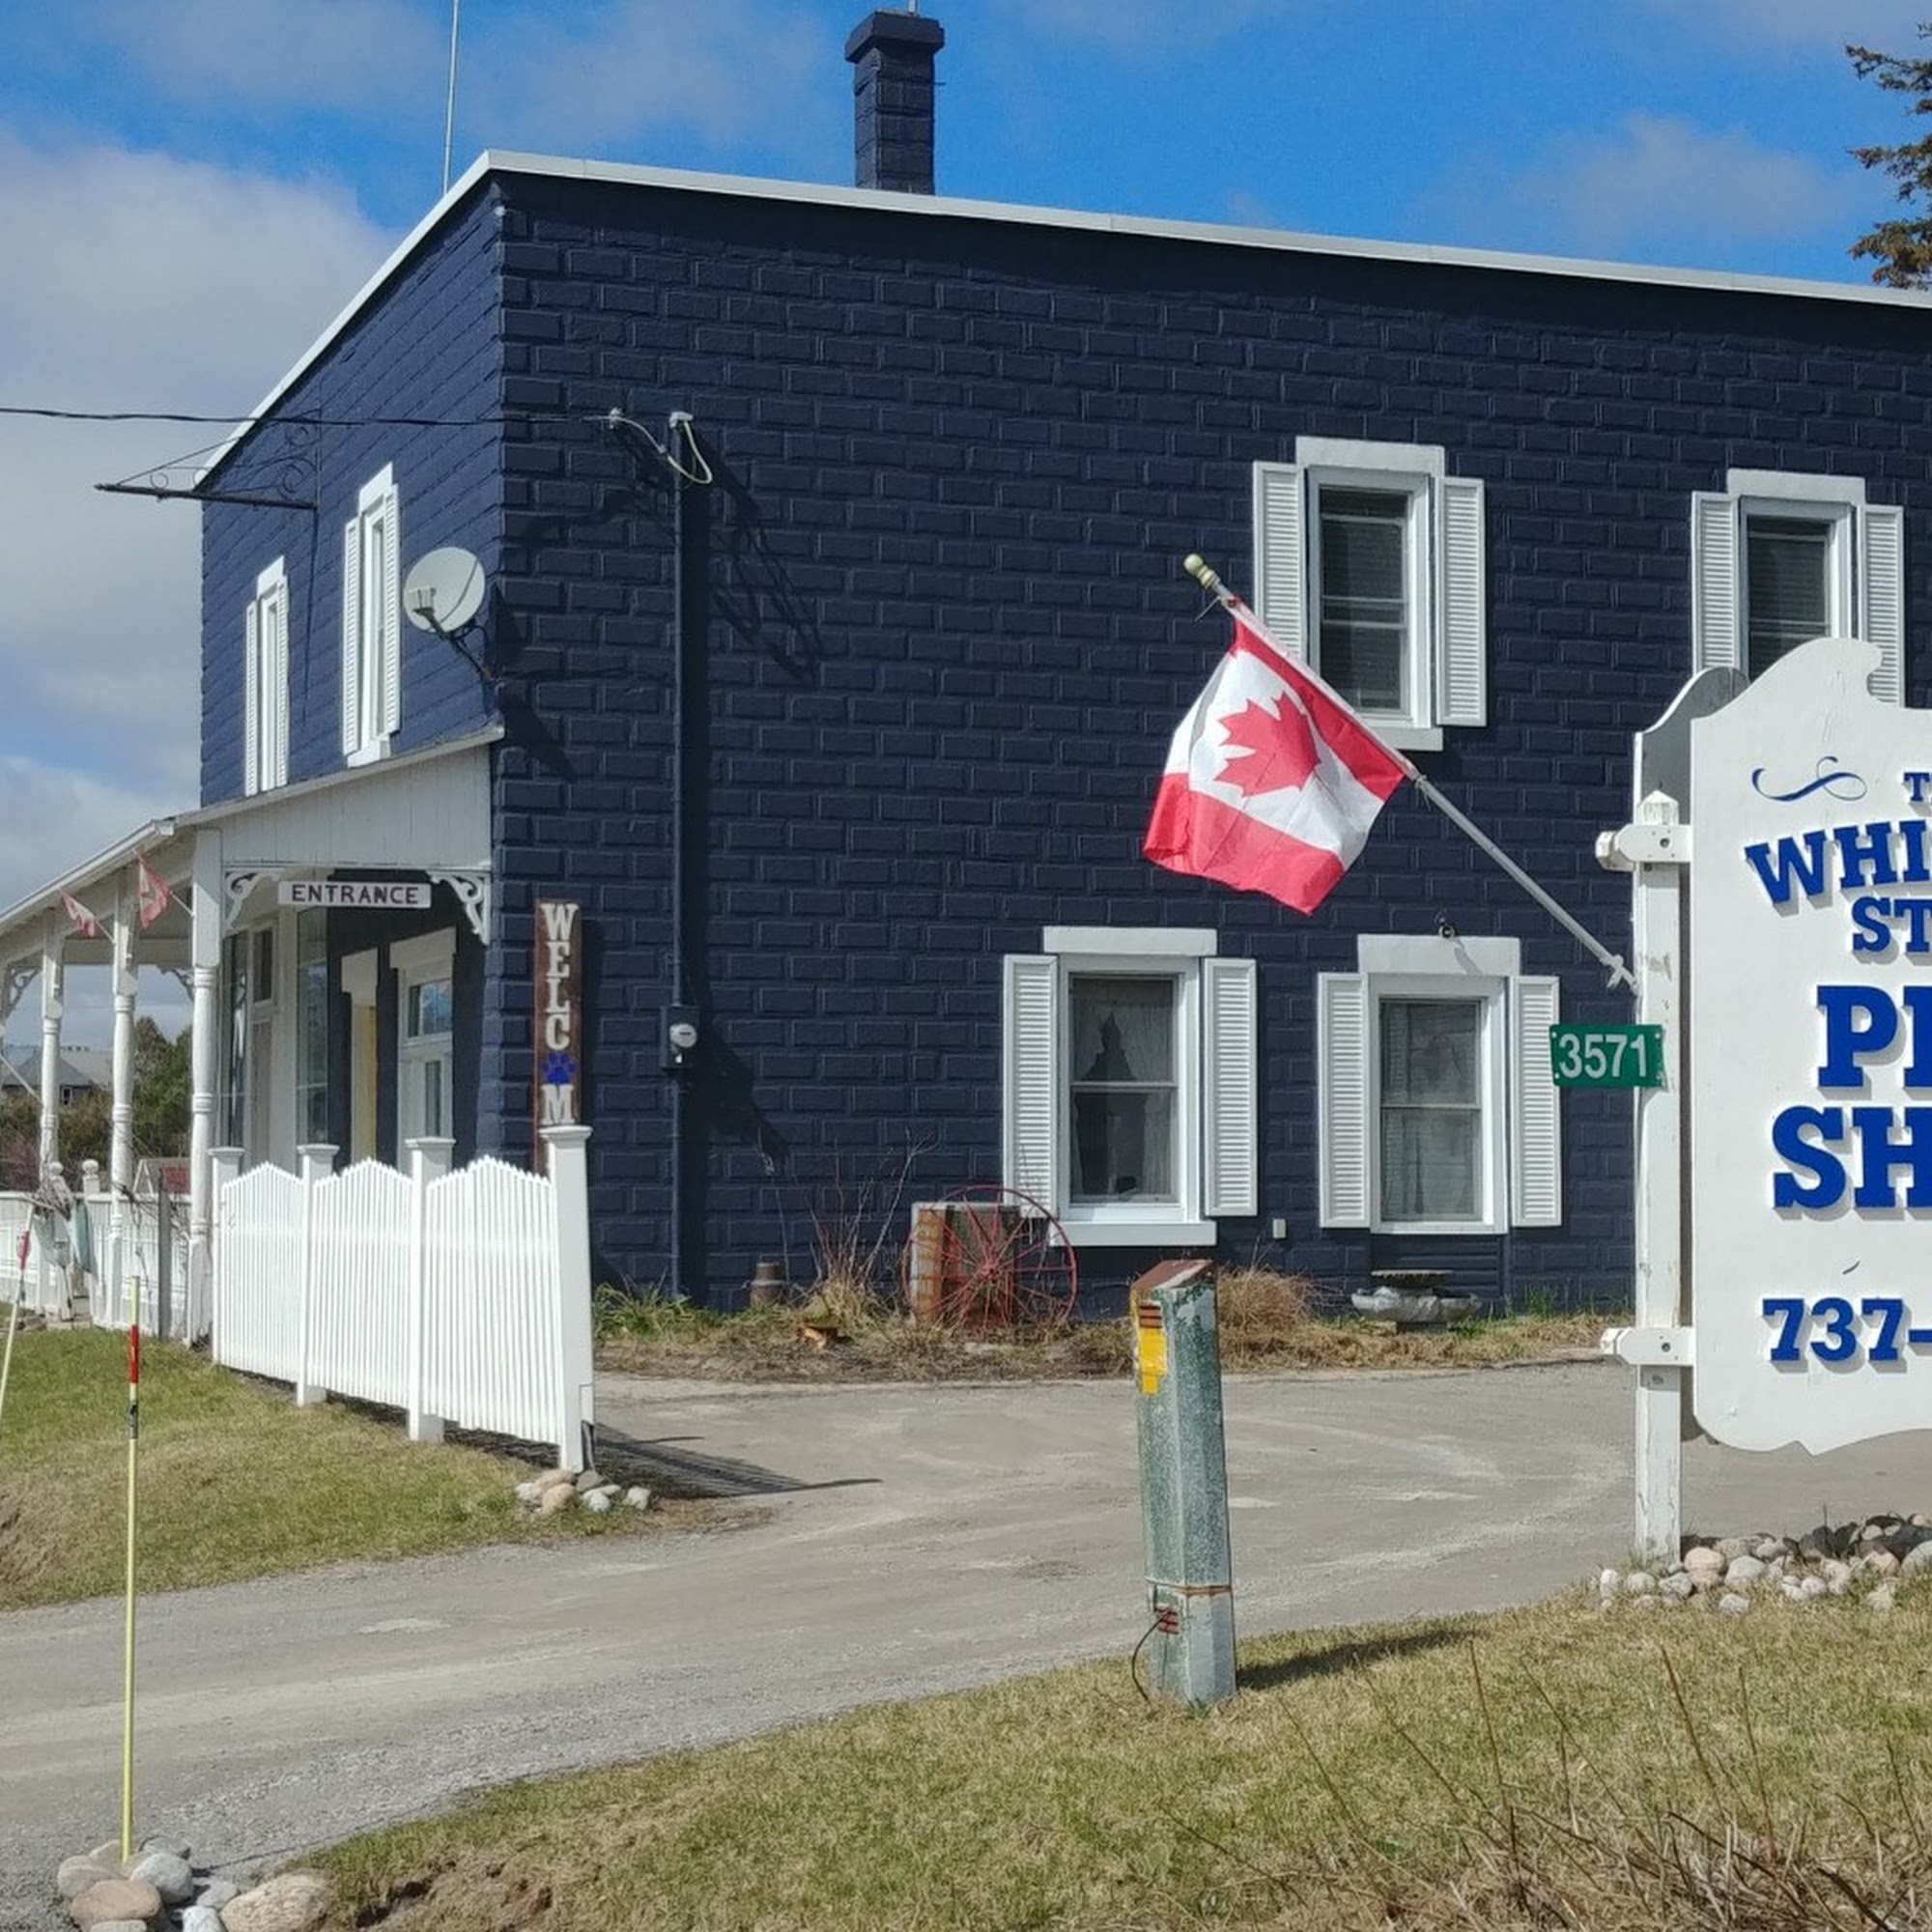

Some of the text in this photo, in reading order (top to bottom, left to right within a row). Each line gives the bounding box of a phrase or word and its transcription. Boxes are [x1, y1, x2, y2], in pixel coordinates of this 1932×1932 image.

[1903, 772, 1932, 802] T
[292, 884, 419, 904] ENTRANCE
[540, 903, 579, 1125] WELCM
[1559, 1033, 1647, 1079] 3571
[1772, 1105, 1932, 1209] SH
